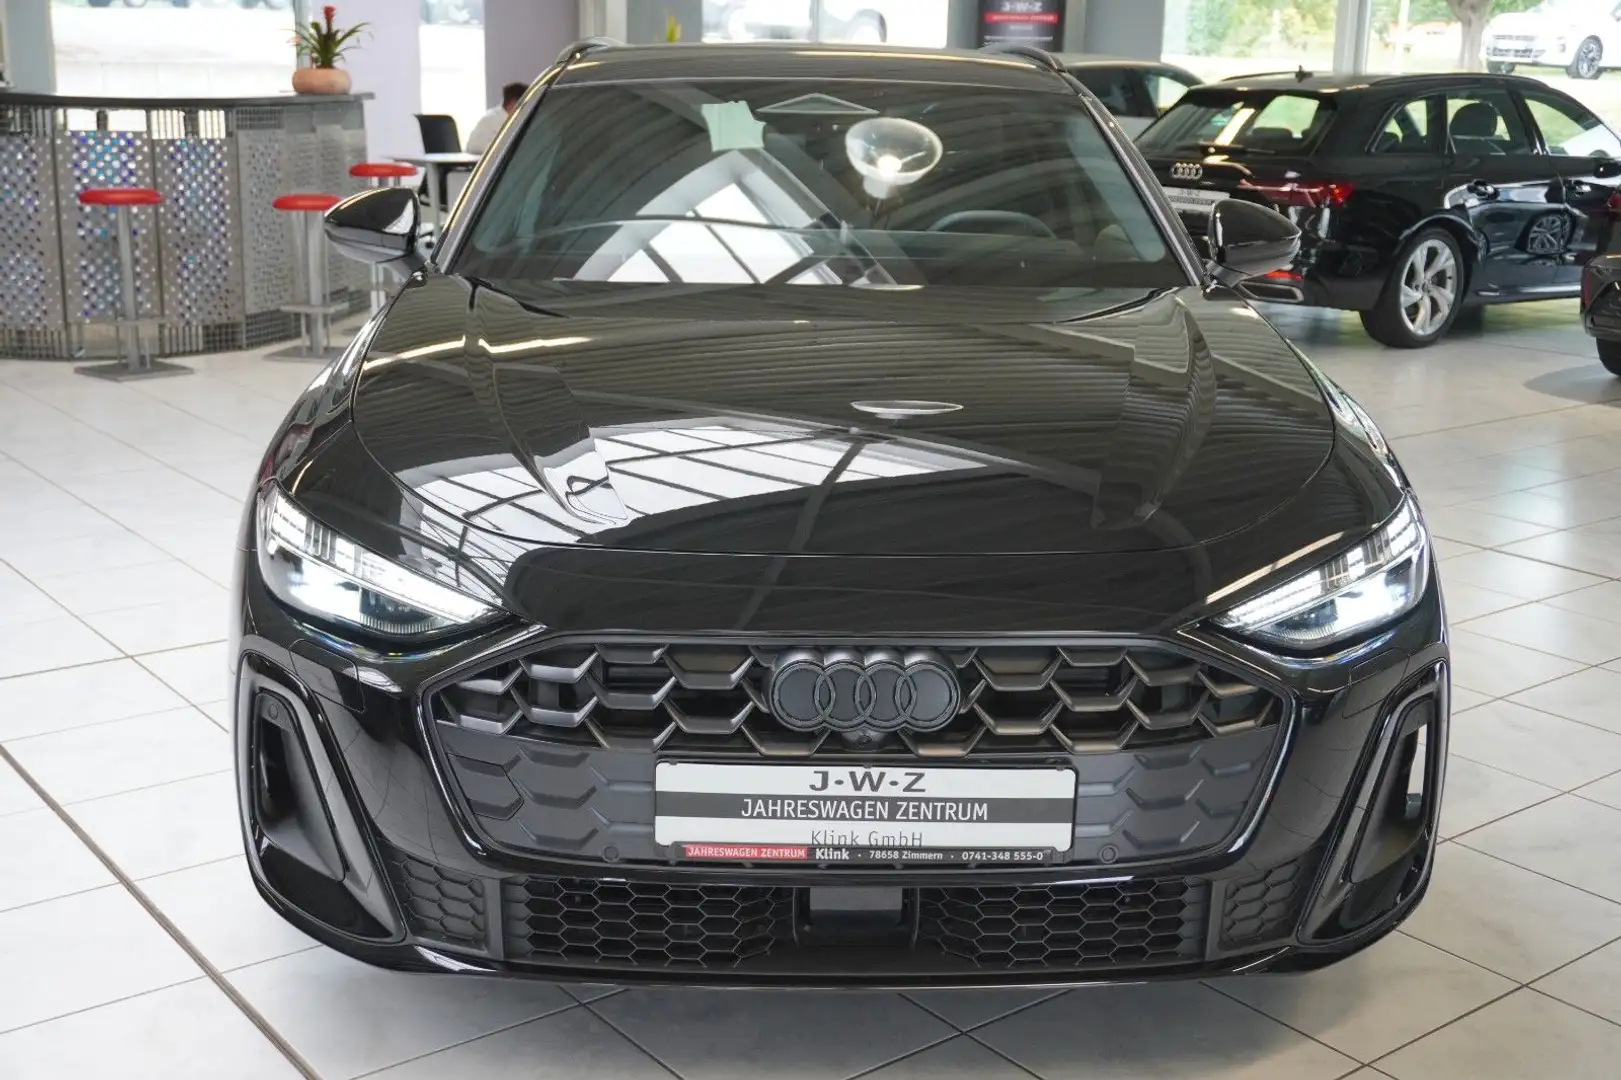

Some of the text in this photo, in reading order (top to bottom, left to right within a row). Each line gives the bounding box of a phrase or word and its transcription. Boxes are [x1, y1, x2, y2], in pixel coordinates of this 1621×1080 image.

[741, 798, 989, 822] JAHRESWAGEN ZENTRUM
[811, 830, 923, 848] Klink GmbH
[688, 847, 1043, 861] JAHRESWAGEN ZENTRUM Klink 78658 Zimmern 0741-348 555-0
